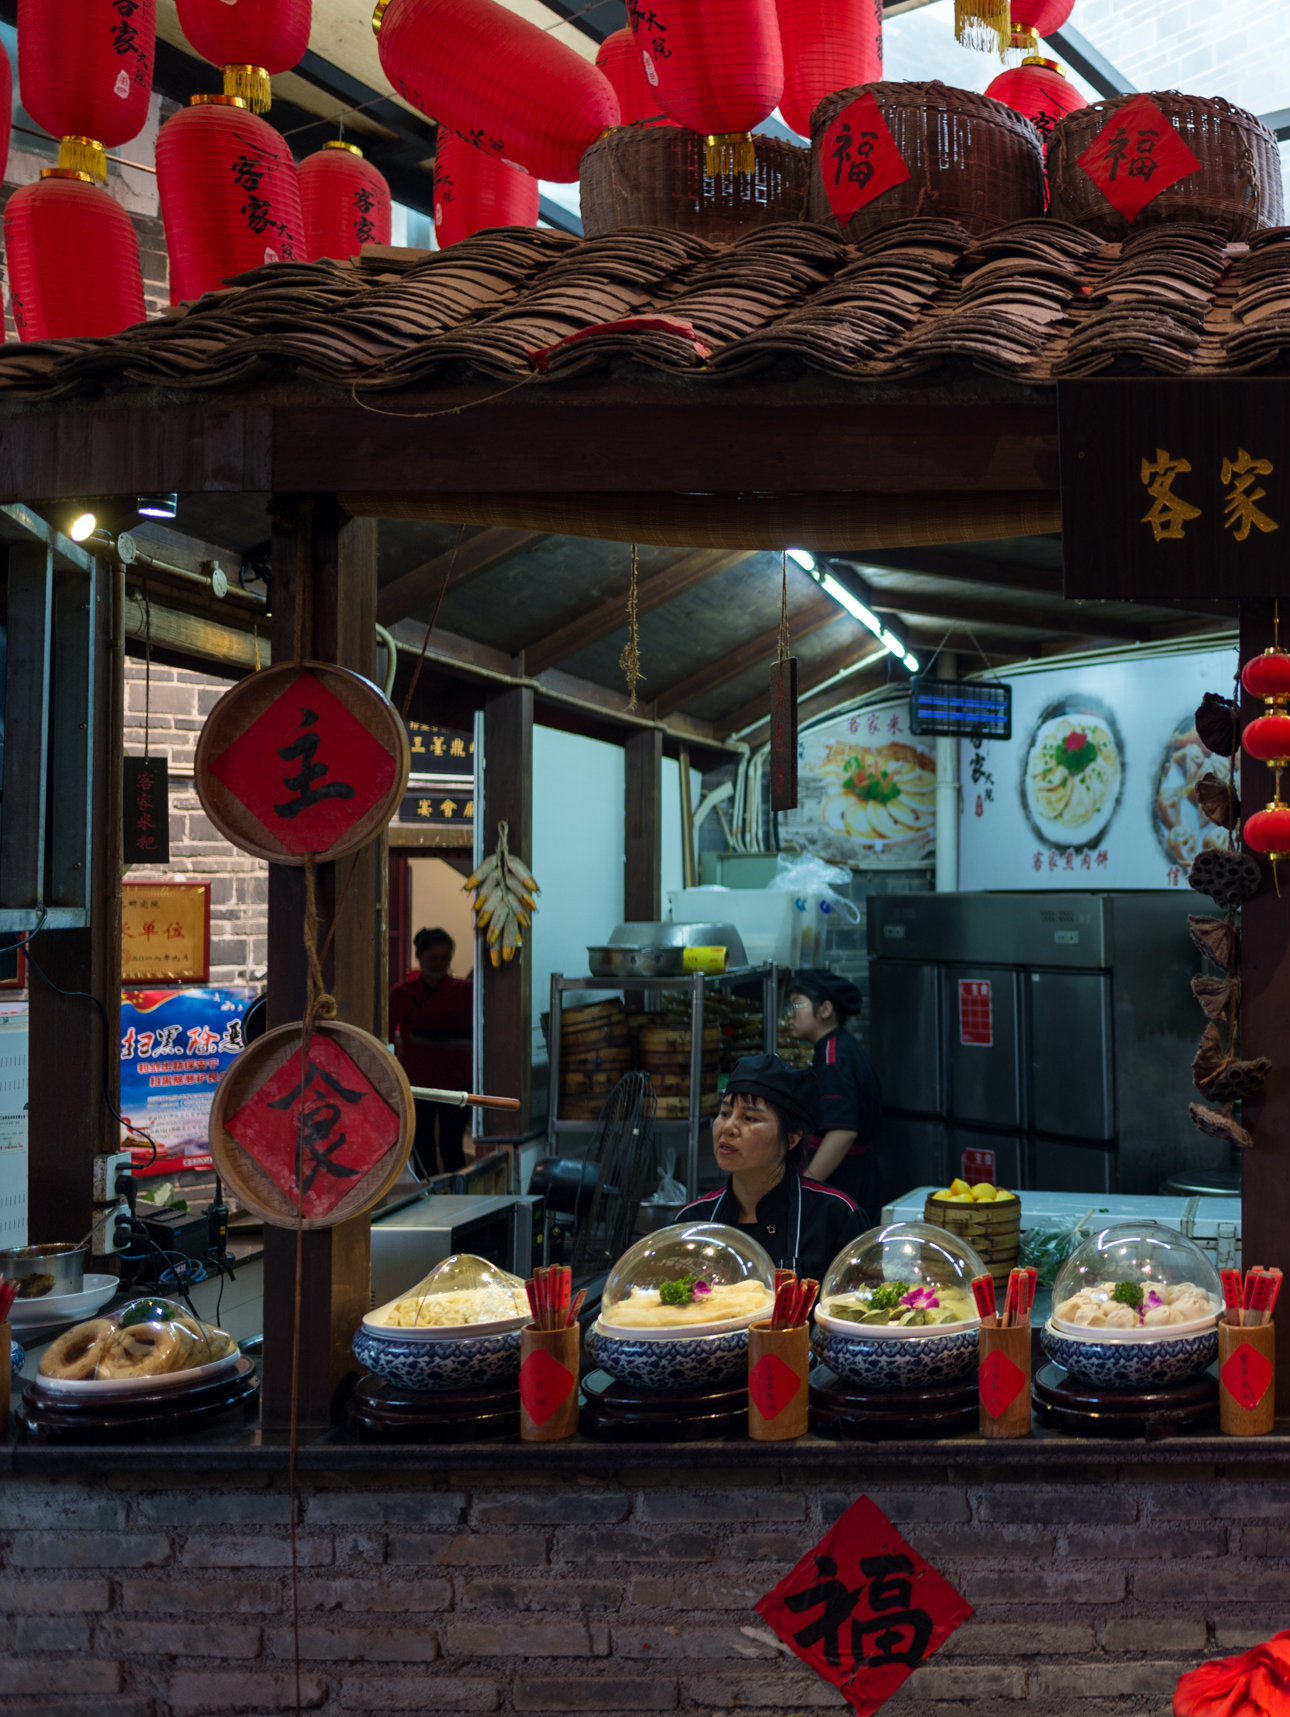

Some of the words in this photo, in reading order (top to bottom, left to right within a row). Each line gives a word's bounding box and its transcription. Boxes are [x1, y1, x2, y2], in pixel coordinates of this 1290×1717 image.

[829, 123, 879, 189] 福
[1102, 127, 1160, 183] 福
[848, 711, 915, 738] 客家米
[273, 707, 356, 820] 主
[149, 1071, 227, 1088] 扫黑除恶护民
[267, 1060, 371, 1196] 食
[782, 1553, 935, 1670] 福
